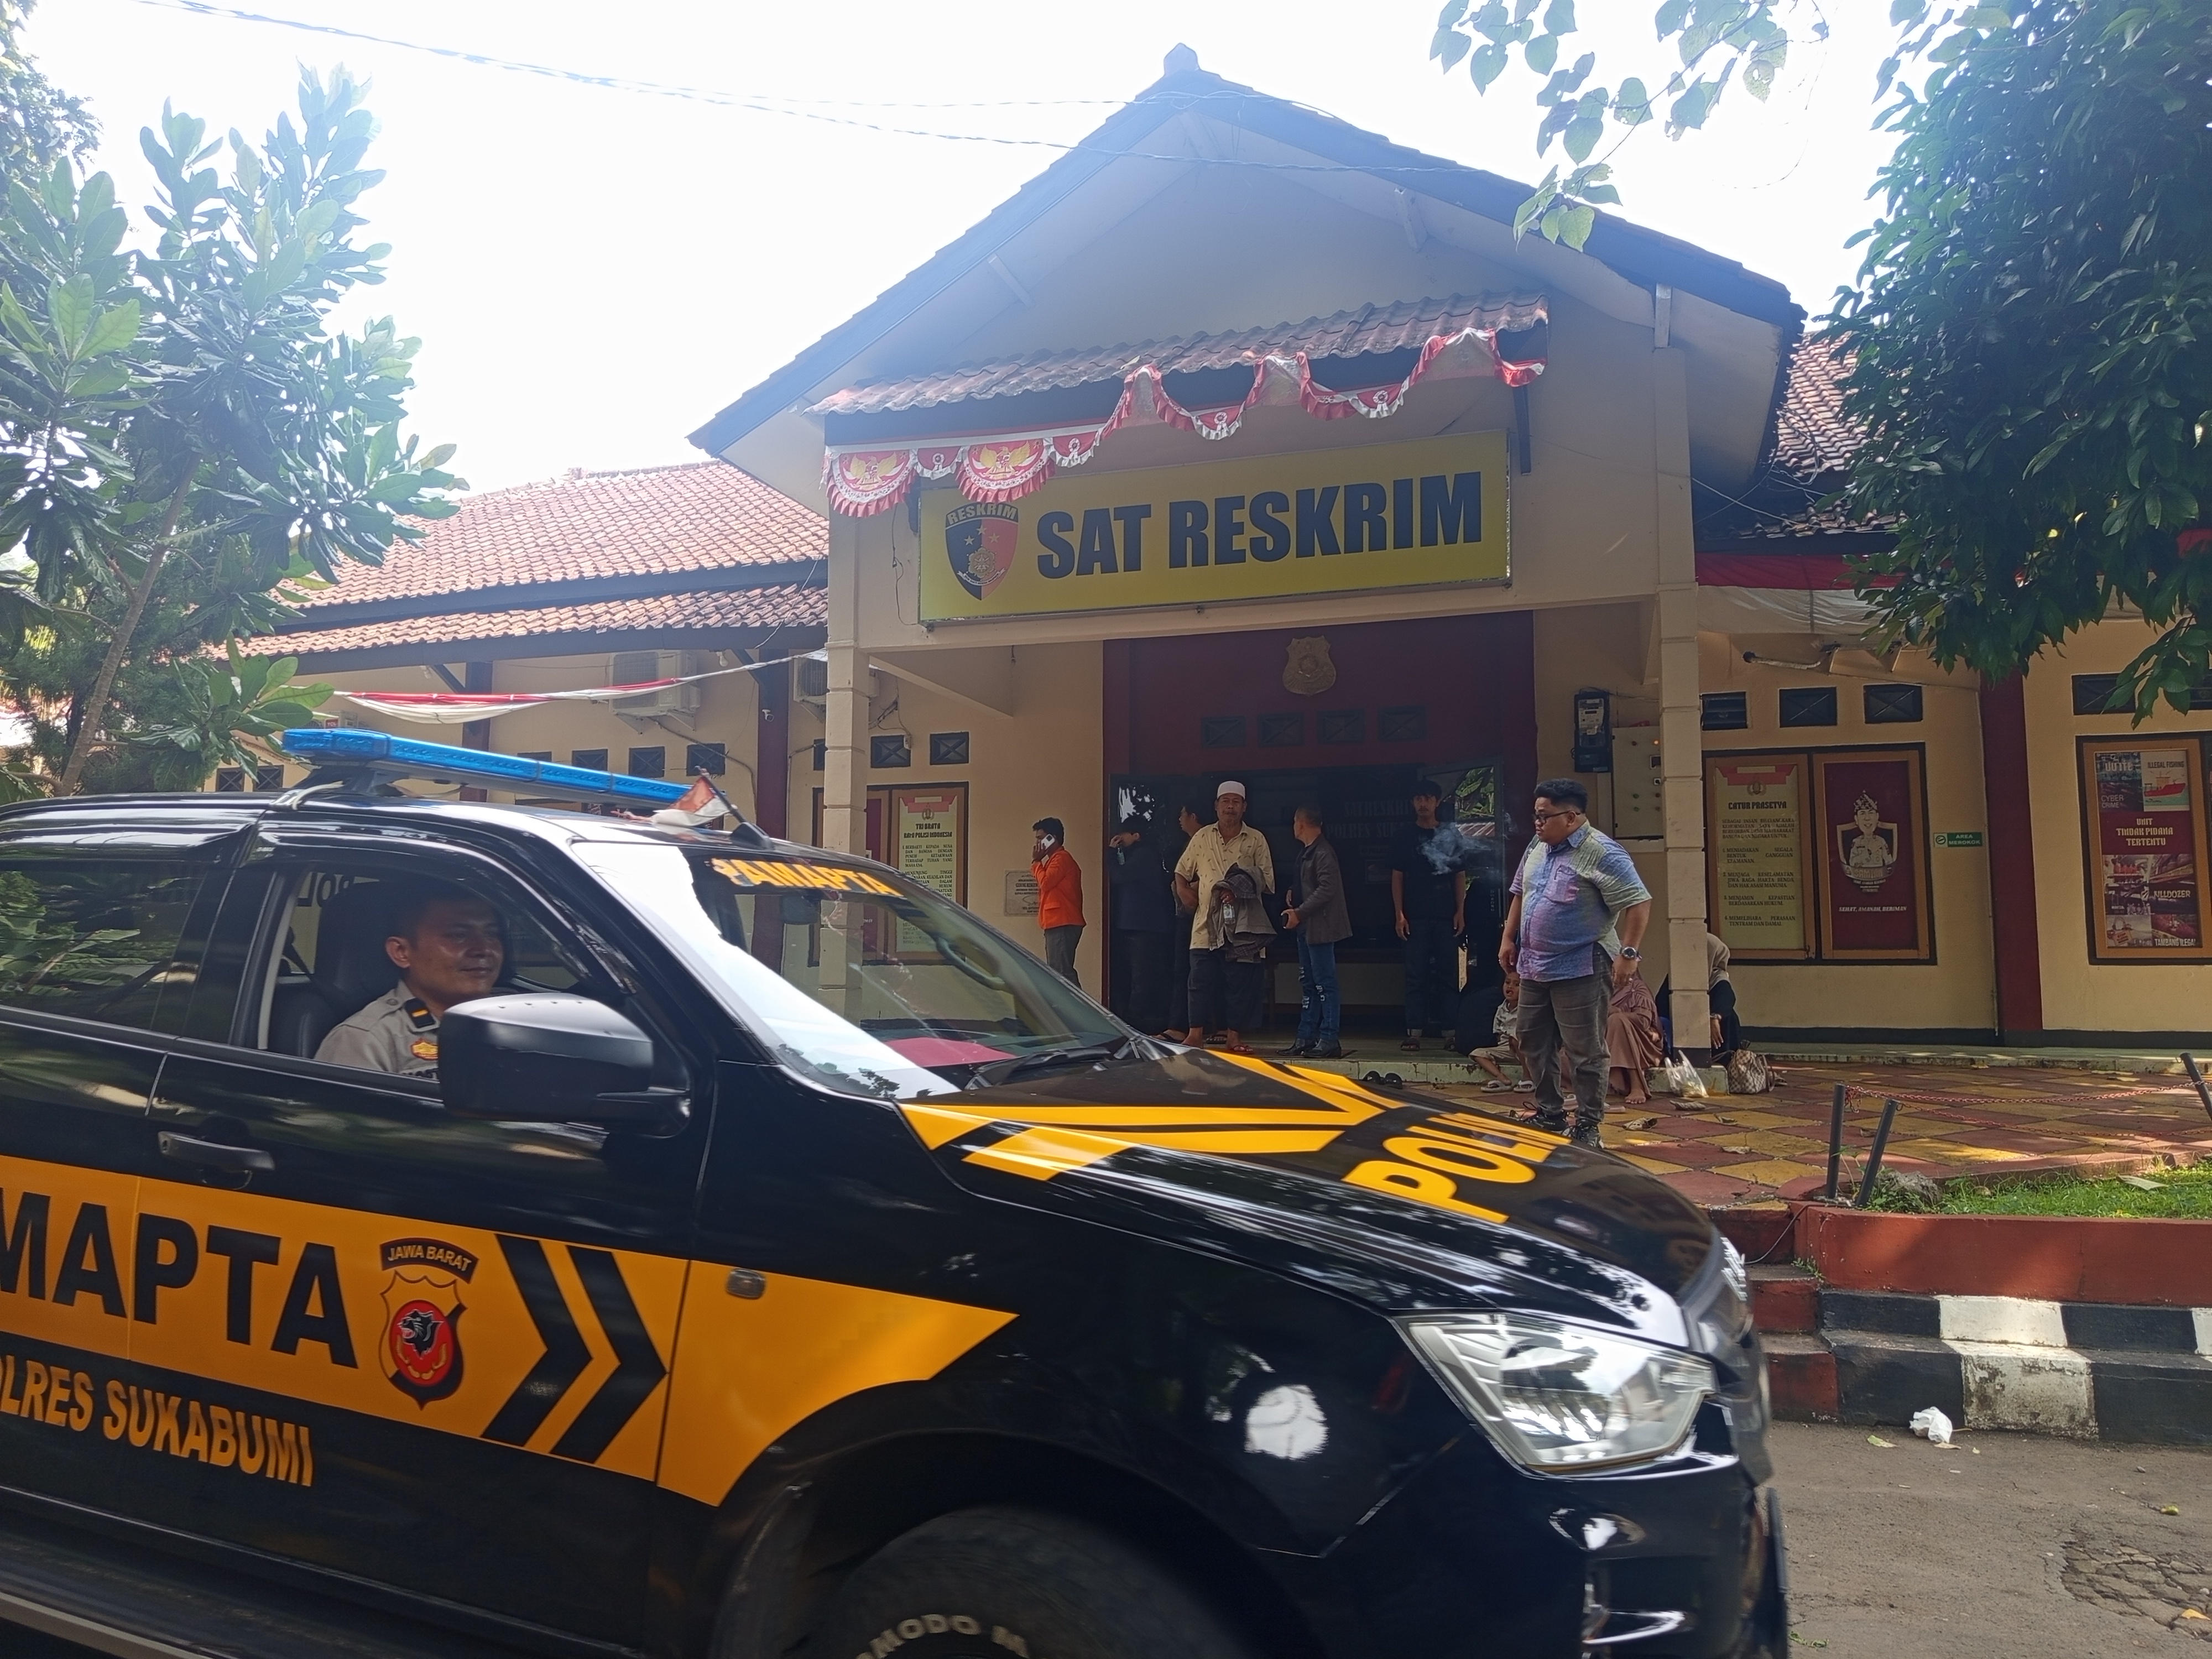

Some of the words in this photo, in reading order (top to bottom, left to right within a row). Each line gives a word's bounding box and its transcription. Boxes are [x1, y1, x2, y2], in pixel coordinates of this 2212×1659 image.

[947, 504, 1017, 525] RESKRIM
[1036, 503, 1151, 580] SAT
[1169, 471, 1482, 569] RESKRIM
[2126, 838, 2166, 846] TERTENTU
[2146, 827, 2173, 836] PIDANA
[2154, 938, 2179, 946] TAMBANG
[388, 1245, 425, 1261] JAWA
[426, 1246, 472, 1271] BARAT
[0, 1354, 94, 1432] LRES
[103, 1380, 314, 1486] SUKABUMI
